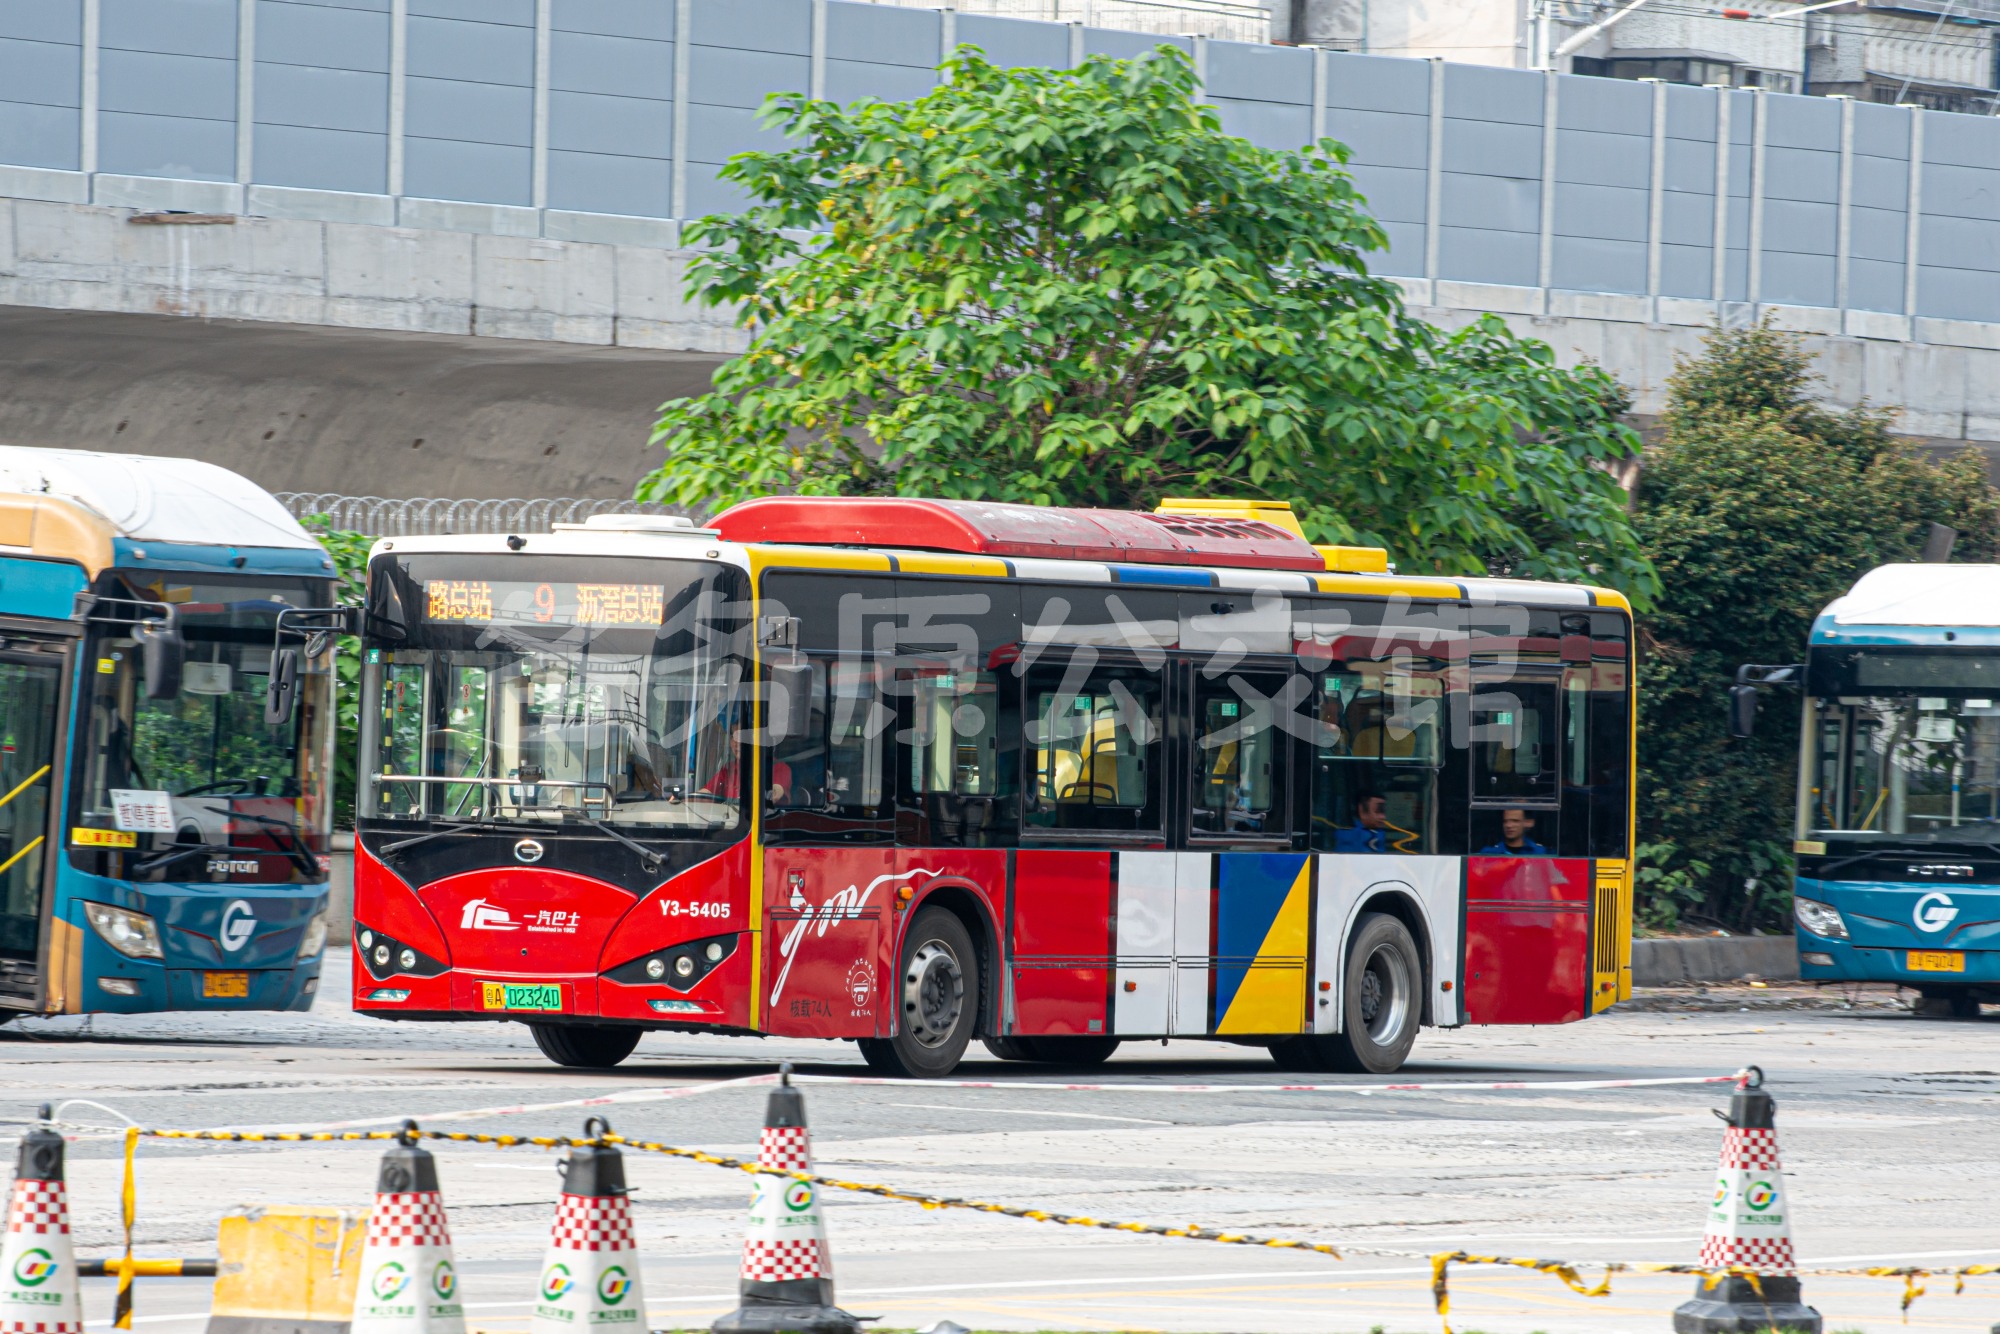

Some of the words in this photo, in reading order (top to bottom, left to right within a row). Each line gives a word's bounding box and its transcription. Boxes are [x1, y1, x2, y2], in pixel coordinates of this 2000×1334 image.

[428, 581, 493, 620] 路总站
[534, 583, 556, 623] 9
[523, 909, 581, 927] 一汽巴士
[659, 899, 731, 919] Y3-5405
[790, 997, 832, 1018] 核载74人
